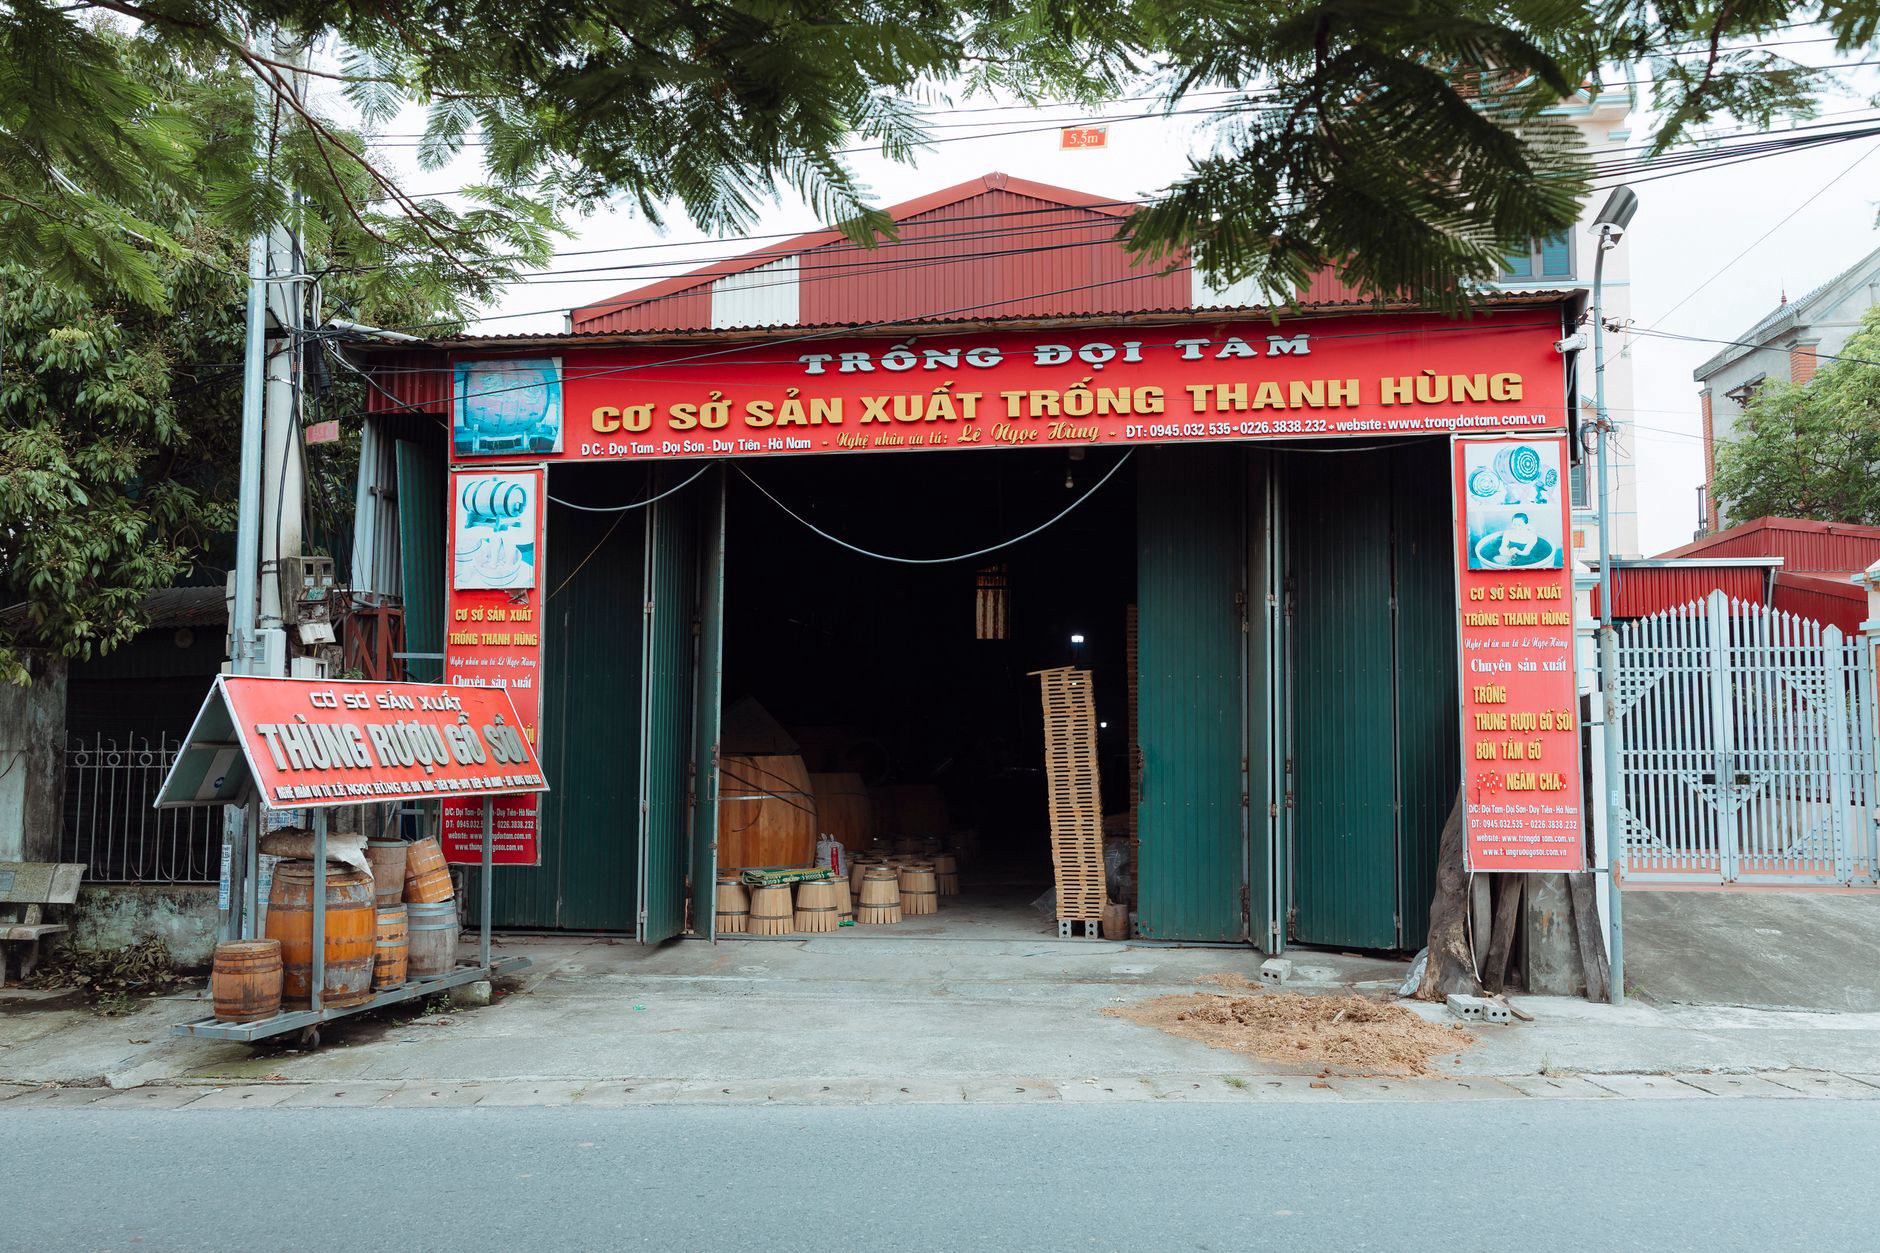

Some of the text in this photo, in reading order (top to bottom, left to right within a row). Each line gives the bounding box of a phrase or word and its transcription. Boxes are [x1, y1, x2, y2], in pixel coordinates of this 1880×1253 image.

[798, 334, 1312, 374] TRỐNG ĐỌI TAM
[591, 369, 1523, 433] CƠ SỞ SẢN XUẤT TRỐNG THANH HÙNG
[609, 442, 628, 457] Đọi
[630, 442, 654, 454] Tam
[684, 440, 704, 454] Sơn
[712, 439, 734, 454] Duy
[738, 438, 761, 452] Tiên
[768, 438, 783, 450] Hà
[786, 437, 811, 450] Nam
[836, 431, 868, 450] Nghệ
[874, 431, 904, 446] nhân
[957, 424, 982, 442] Lê
[990, 423, 1038, 446] Ngọc
[1048, 422, 1100, 443] Hùng
[1126, 425, 1148, 438] ĐT:
[1470, 582, 1562, 600] CƠ SỞ SẢN XUẤT
[455, 605, 532, 622] CƠ SỞ SẢN XUẤT
[1465, 609, 1570, 626] TRỐNG THANH HÙNG
[450, 628, 538, 646] TRỐNG THANH HÙNG
[1470, 656, 1566, 676] Chuyên sản xuất
[512, 674, 532, 688] xuất
[309, 690, 338, 708] CƠ
[376, 690, 414, 710] SẢN
[417, 690, 462, 711] XUẤT
[1474, 682, 1506, 704] TRỐNG
[1475, 708, 1572, 734] THÙNG RƯỢU GỖ SỒI
[255, 712, 530, 774] THÙNG RƯỢU GỖ SỒI
[1476, 736, 1544, 760] BỒN TẮM GỖ
[330, 782, 346, 797] LÊ
[372, 780, 401, 794] HÙNG
[1506, 770, 1536, 791] NGÂM
